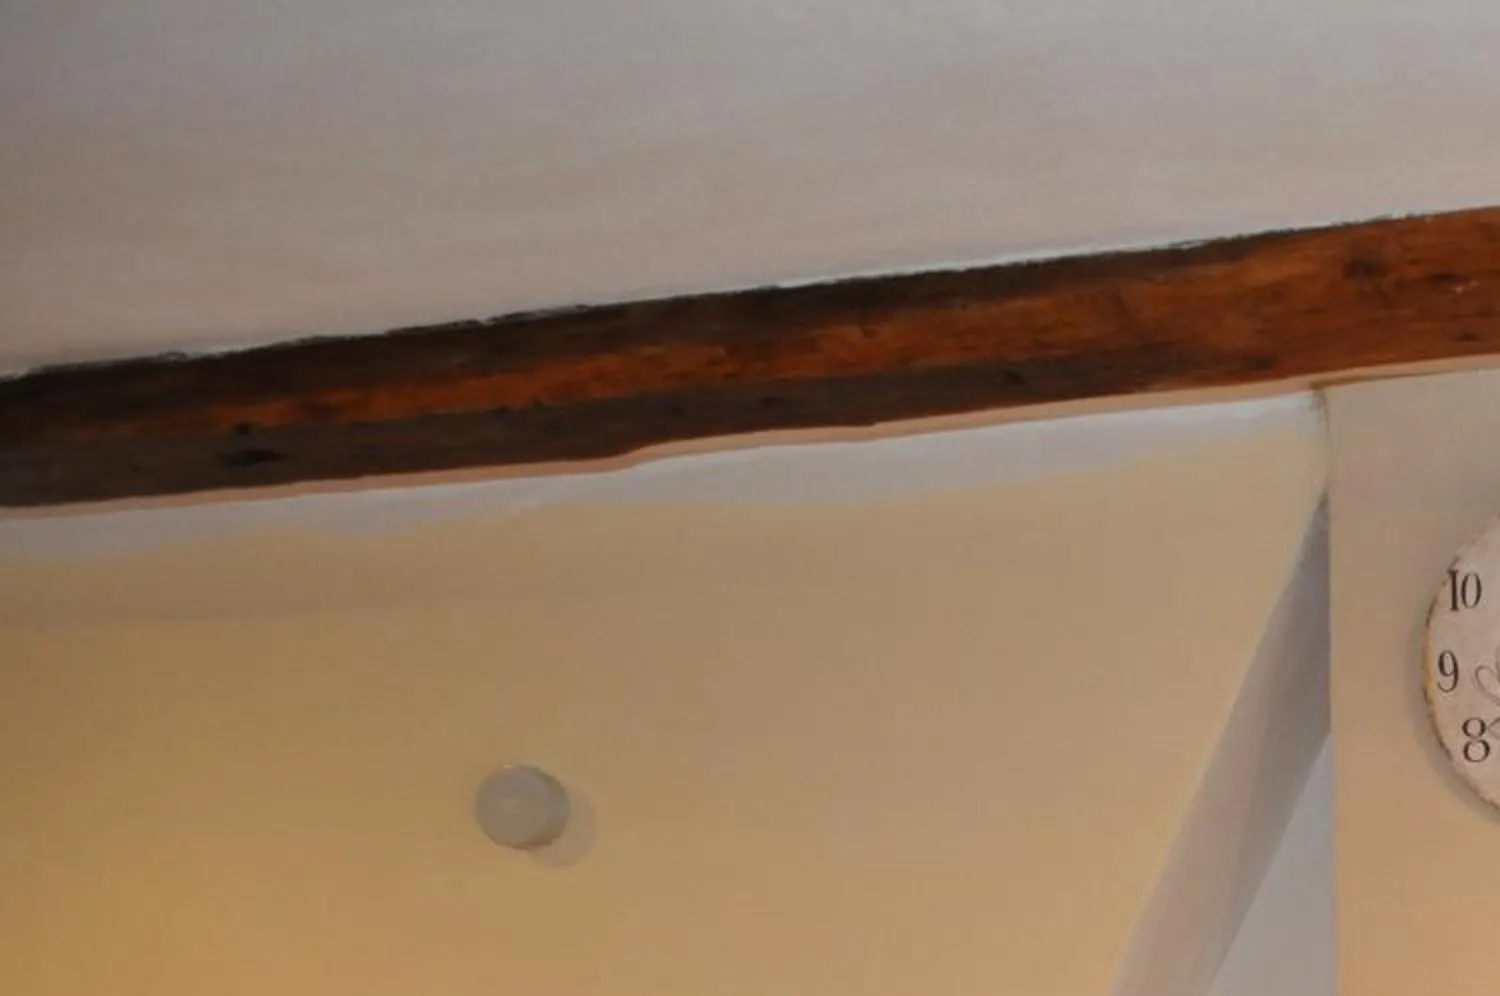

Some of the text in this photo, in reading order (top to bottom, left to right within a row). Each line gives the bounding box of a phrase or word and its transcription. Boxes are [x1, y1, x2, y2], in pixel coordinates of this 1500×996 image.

[1448, 570, 1482, 612] 10
[1437, 650, 1459, 692] 9
[1462, 717, 1490, 763] 8
